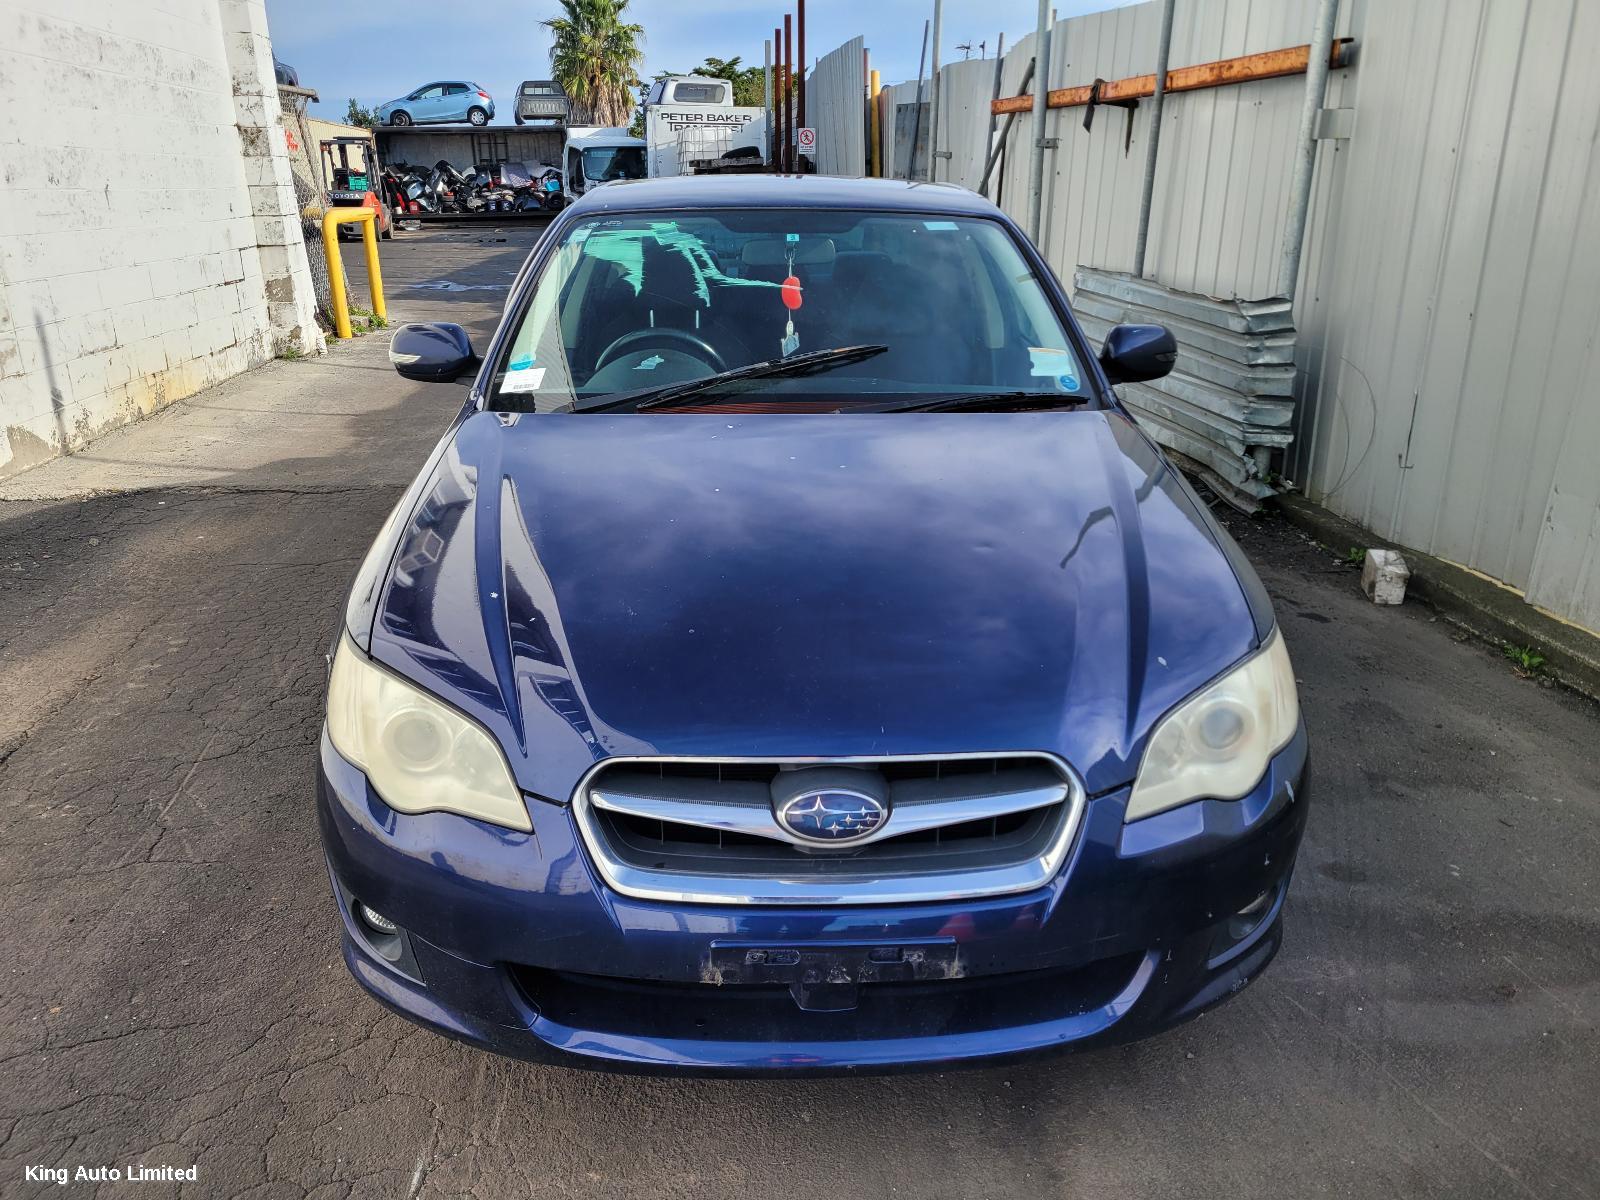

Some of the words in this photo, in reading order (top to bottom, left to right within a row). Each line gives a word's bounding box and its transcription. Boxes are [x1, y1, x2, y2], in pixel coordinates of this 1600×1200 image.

[661, 112, 704, 122] PETER
[706, 113, 752, 123] BAKER
[667, 121, 745, 133] TRANRT
